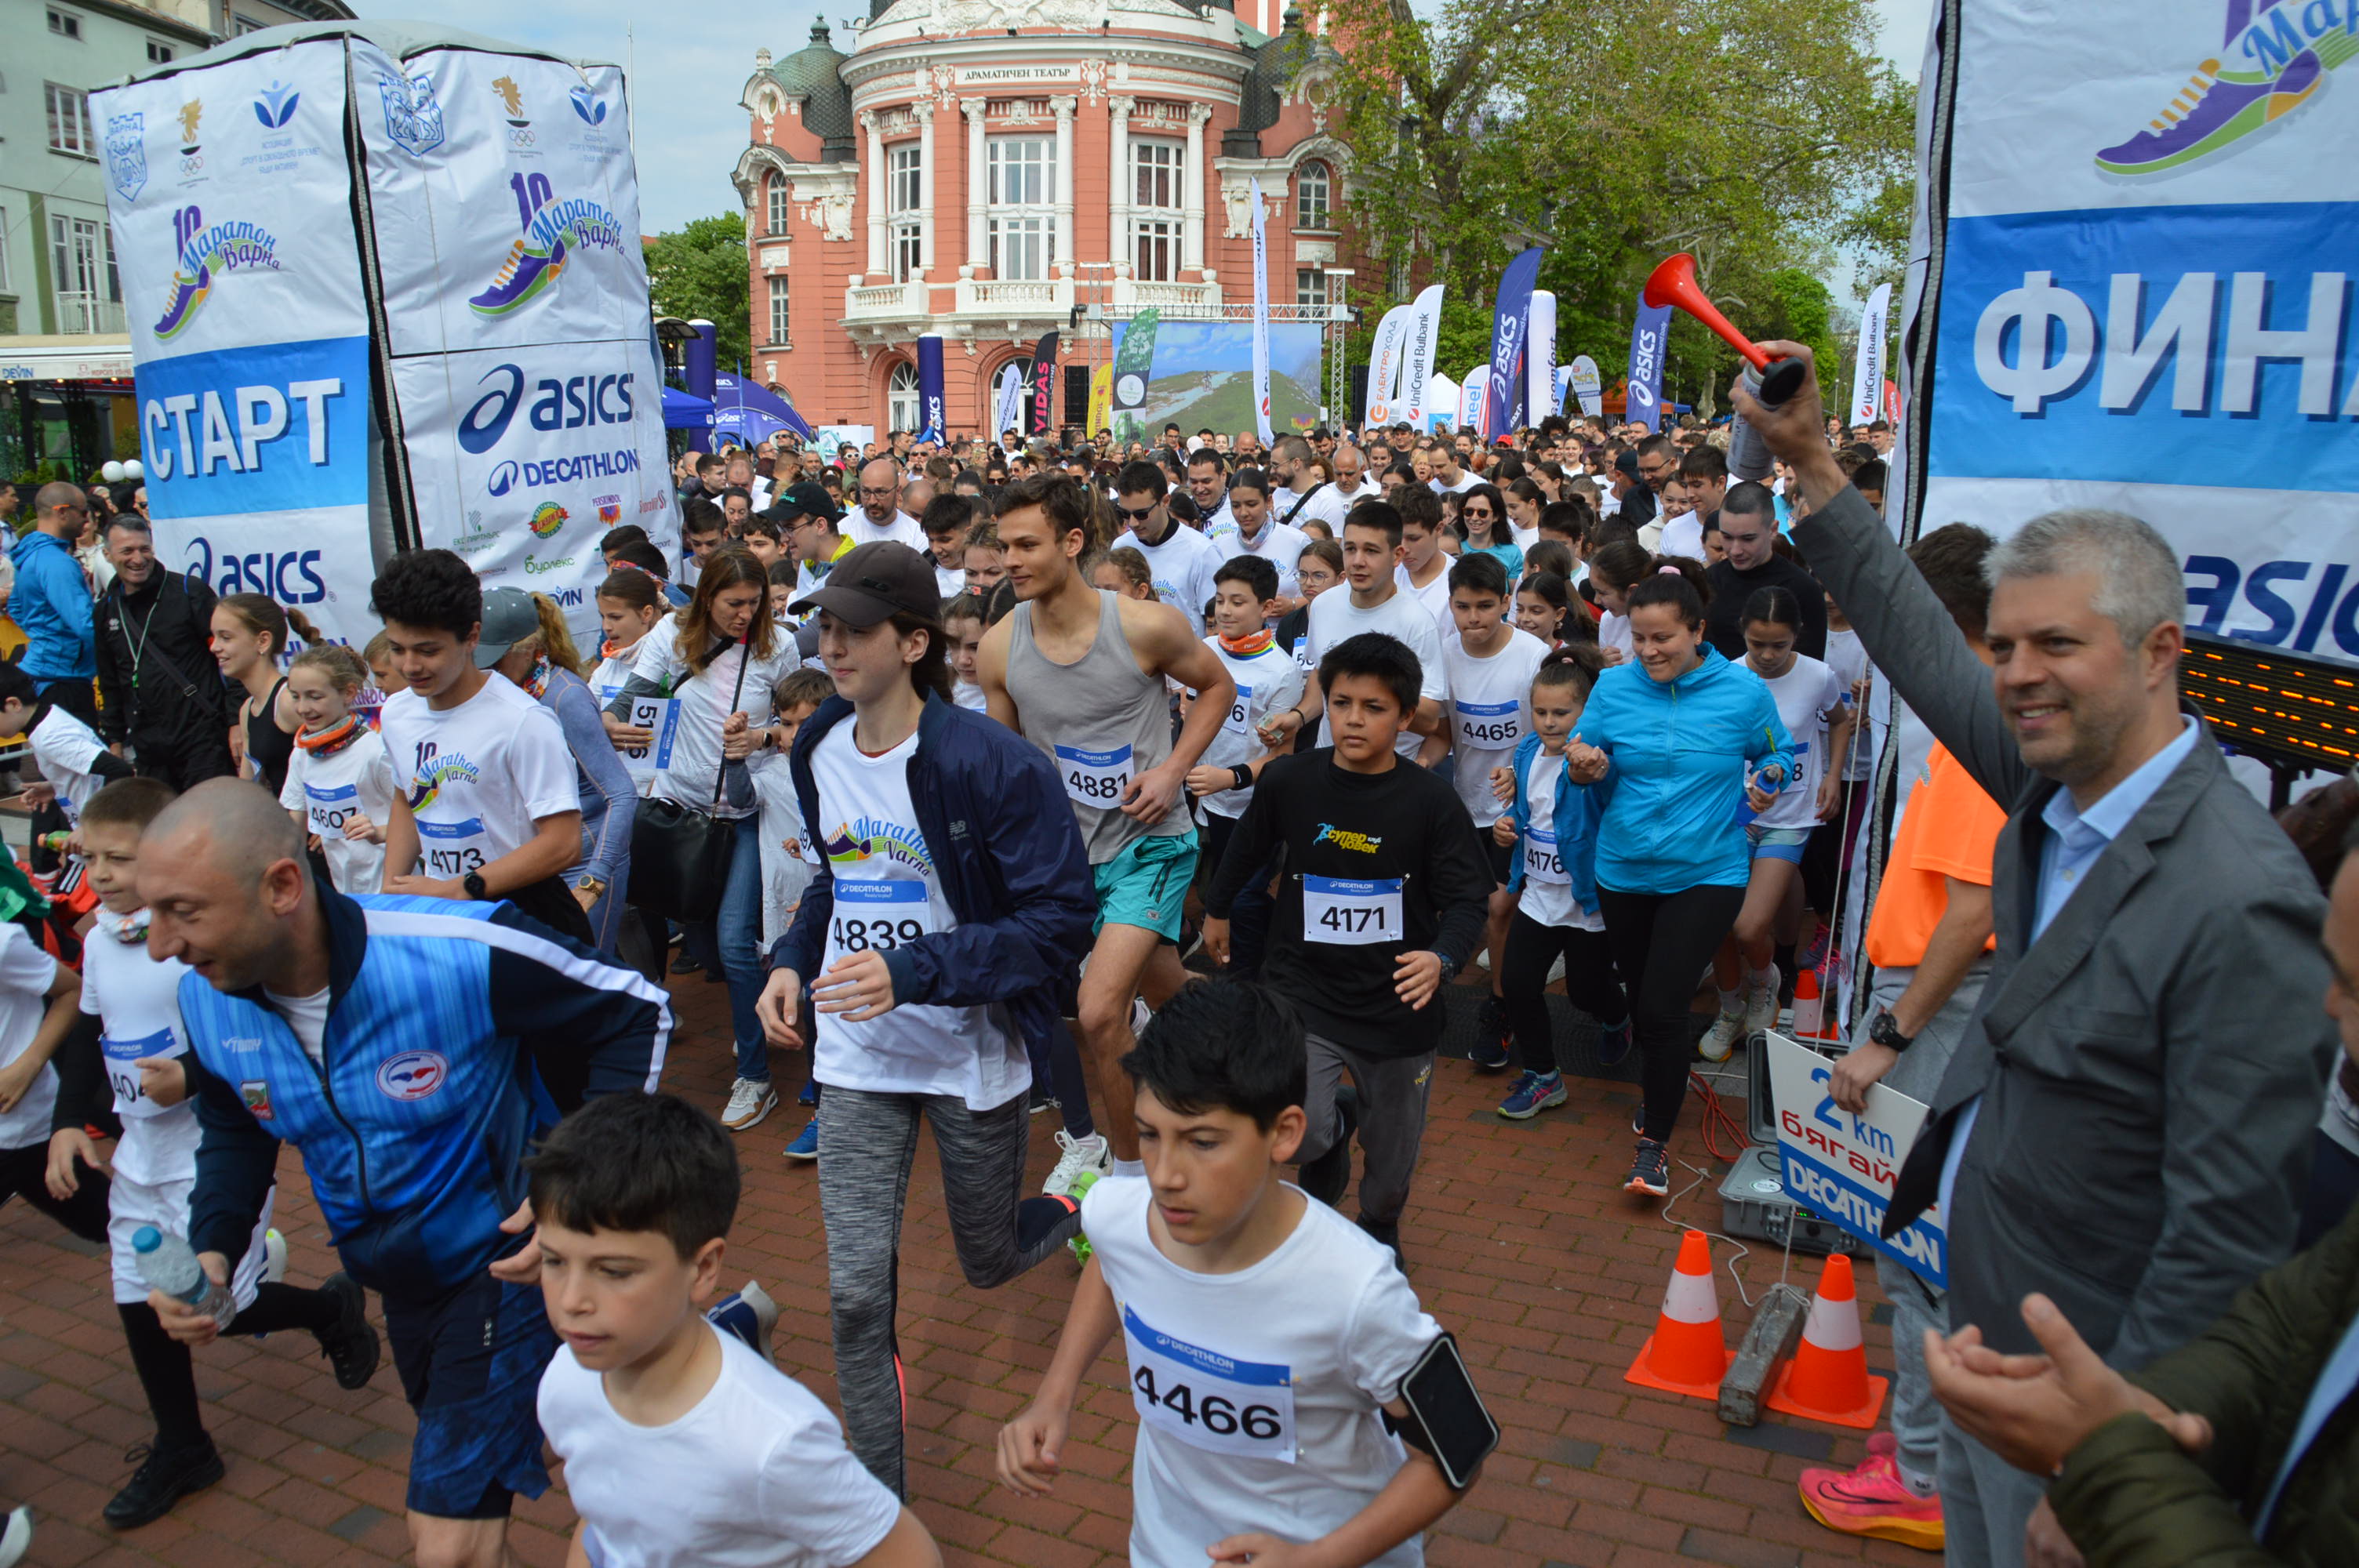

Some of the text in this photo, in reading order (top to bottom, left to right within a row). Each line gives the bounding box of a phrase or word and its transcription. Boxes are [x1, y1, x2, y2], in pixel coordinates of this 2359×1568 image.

[1034, 68, 1071, 78] ТЕАТЪР
[531, 198, 623, 253] Маратон
[184, 220, 276, 280] Маратон
[220, 241, 281, 270] Варна
[1863, 311, 1878, 404] UniCredit Bulbank
[1973, 270, 2359, 419] ФИН
[2, 368, 34, 379] DEVIN
[1410, 313, 1430, 407] UniCredit Bulbank
[1034, 361, 1049, 432] VIDAS
[144, 378, 343, 480] СТАРТ
[523, 448, 641, 487] DECATHLON
[1463, 720, 1518, 742] 4465
[420, 751, 480, 782] Marathon
[444, 768, 478, 785] Varna
[1069, 771, 1128, 799] 4881
[1328, 829, 1367, 843] супер
[1339, 840, 1380, 854] човек
[431, 848, 486, 874] 4173
[883, 840, 931, 877] Varna
[1526, 848, 1565, 874] 4176
[1320, 906, 1385, 932] 4171
[834, 916, 924, 953] 4839
[113, 1073, 145, 1103] 40
[1810, 1067, 1896, 1159] 2 km
[1170, 1340, 1235, 1370] DECATHLON
[1134, 1365, 1282, 1440] 4466
